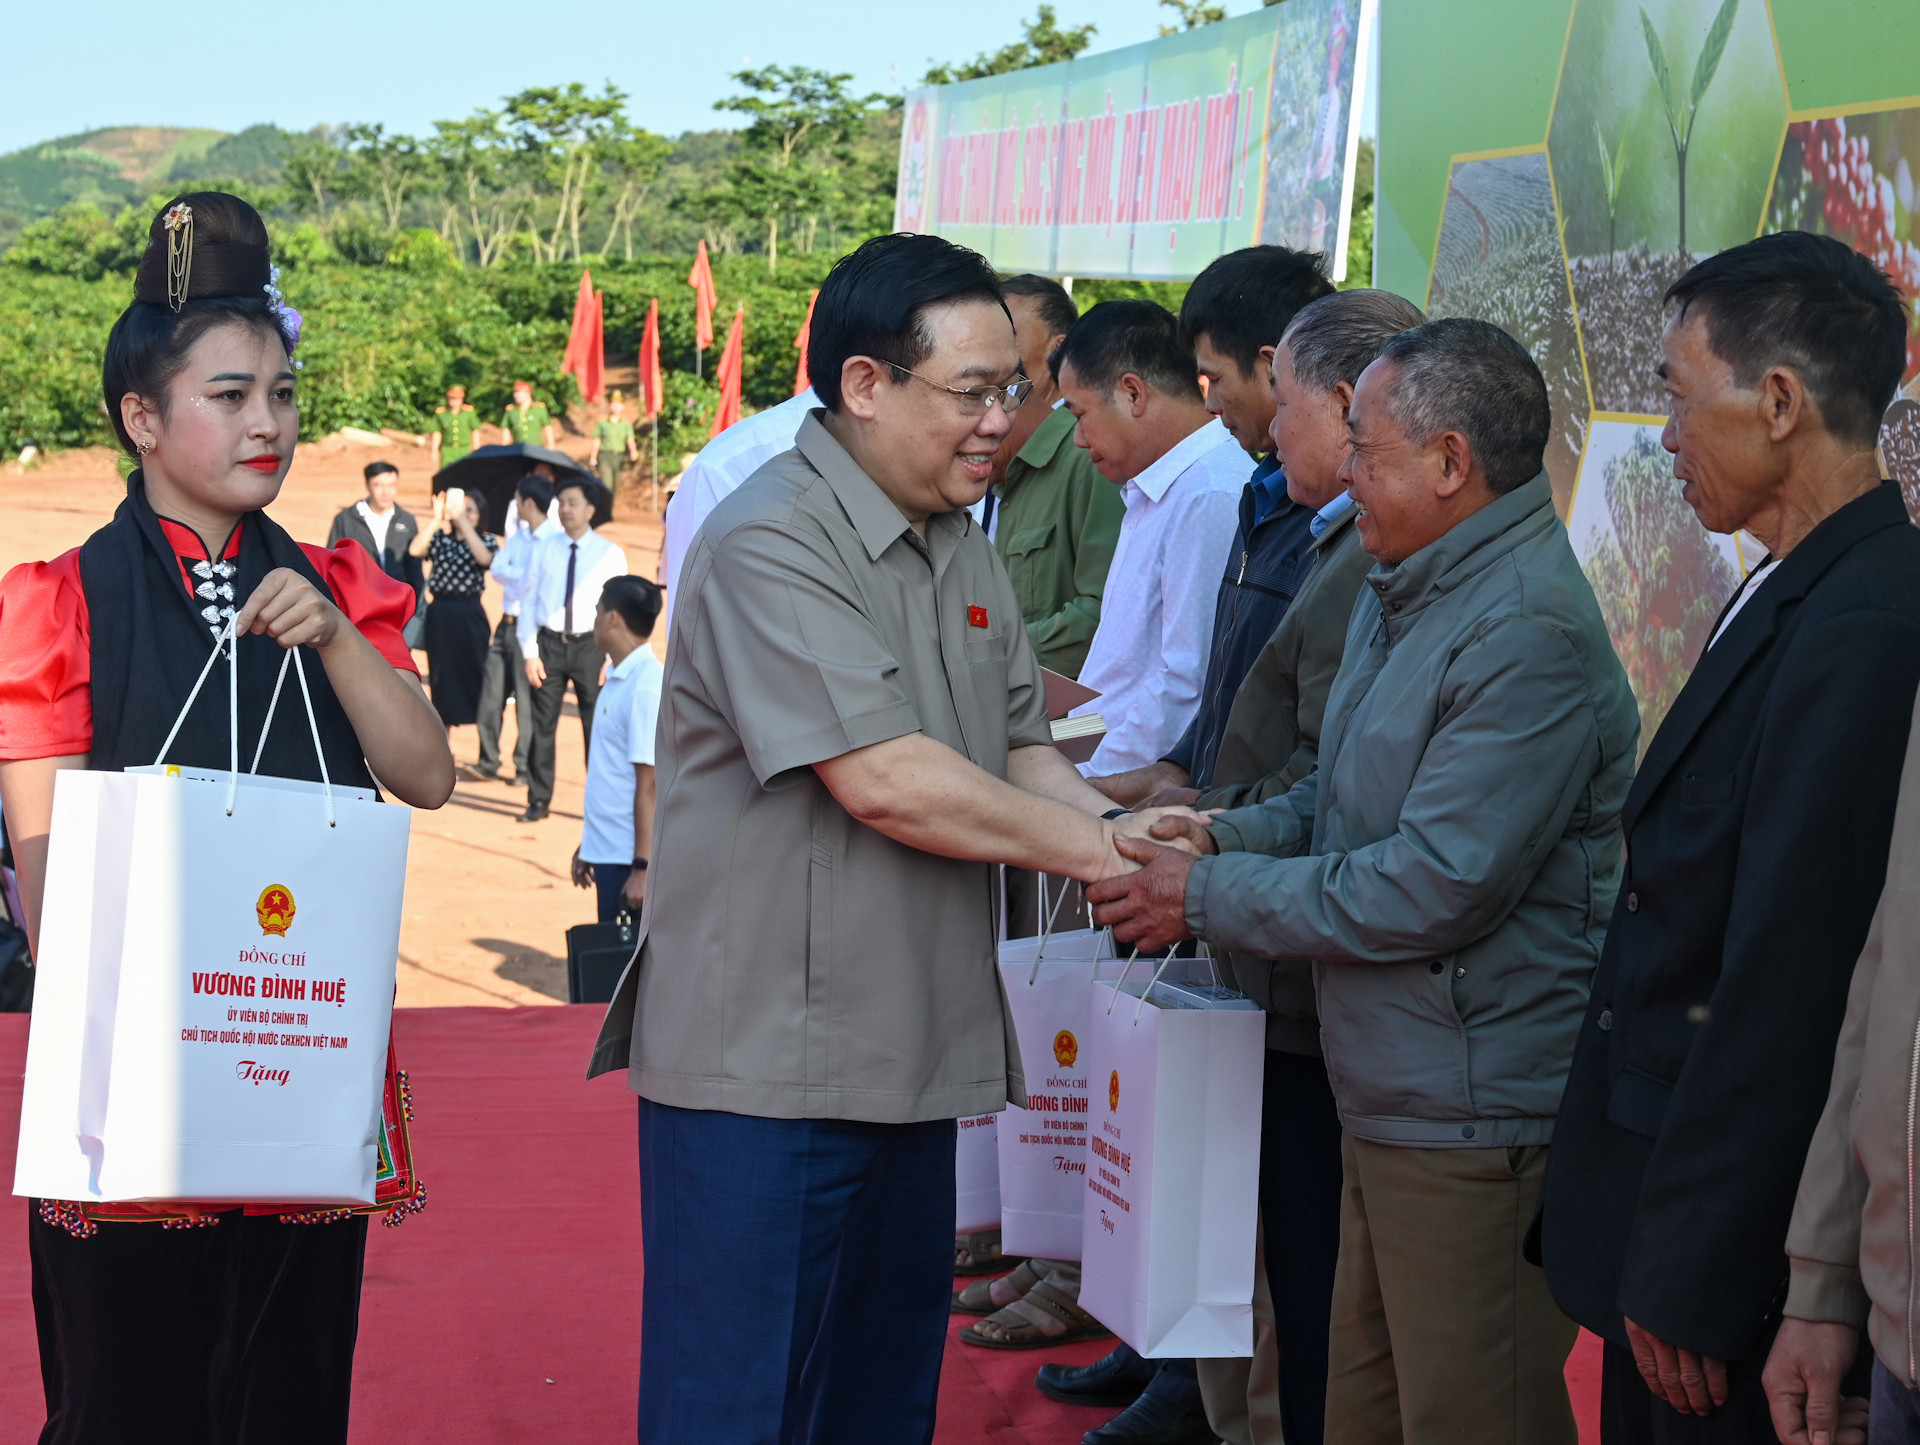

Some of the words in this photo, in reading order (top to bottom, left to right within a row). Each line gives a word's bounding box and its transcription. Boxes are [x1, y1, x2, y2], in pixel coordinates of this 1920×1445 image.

[1155, 96, 1200, 251] MẠO
[1195, 62, 1241, 223] MỚI
[239, 945, 278, 964] ĐỒNG
[282, 951, 306, 967] CHÍ
[192, 971, 256, 998] VƯƠNG
[261, 973, 306, 1001] ĐÌNH
[311, 978, 346, 1008] HUỆ
[227, 1005, 238, 1022] ỦY
[239, 1008, 257, 1023] VIÊN
[259, 1009, 270, 1026] BỘ
[271, 1010, 295, 1025] CHÍNH
[296, 1013, 309, 1029] TRỊ
[181, 1025, 199, 1042] CHỦ
[200, 1030, 218, 1045] TỊCH
[219, 1027, 241, 1045] QUỐC
[242, 1030, 256, 1047] HỘI
[257, 1031, 279, 1046] NƯỚC
[280, 1034, 311, 1048] CHXHCN
[312, 1034, 329, 1050] VIỆT
[330, 1037, 348, 1049] NAM
[235, 1060, 291, 1087] Tặng
[1072, 1077, 1087, 1089] CHÍ
[1027, 1094, 1059, 1112] ƯƠNG
[1061, 1093, 1088, 1113] ĐÌNH
